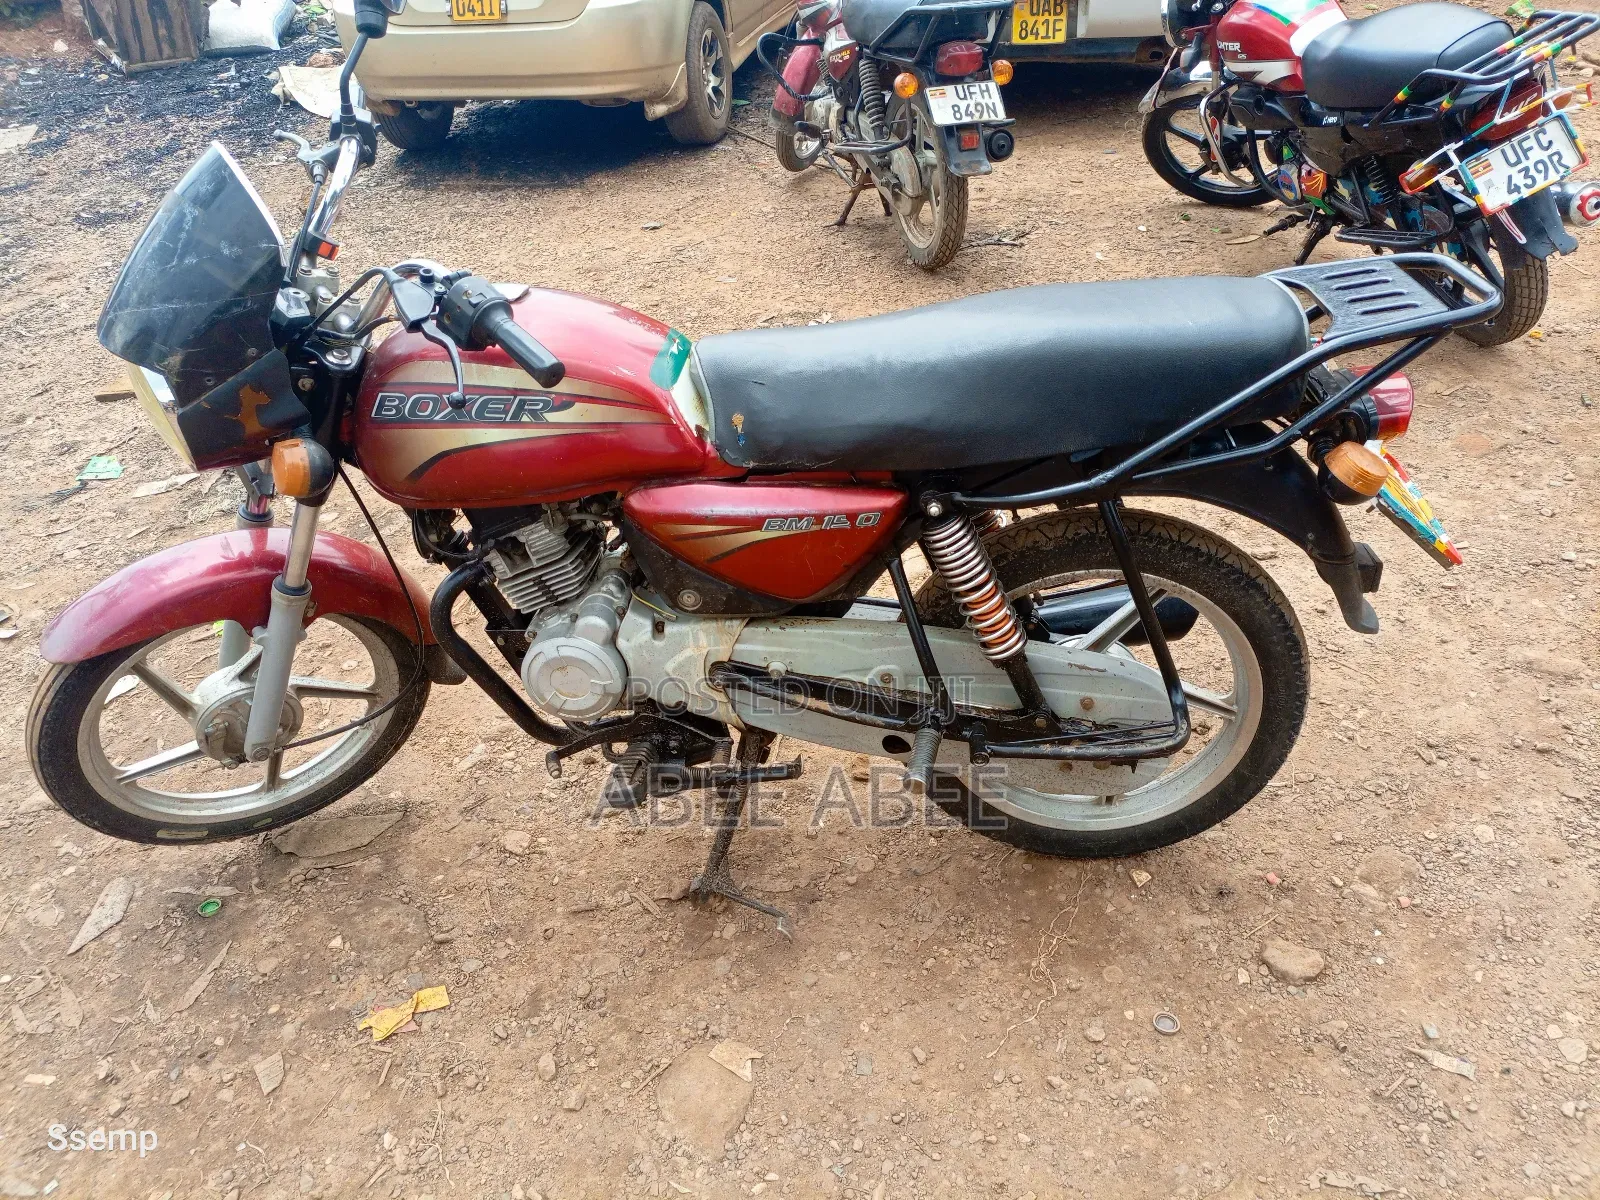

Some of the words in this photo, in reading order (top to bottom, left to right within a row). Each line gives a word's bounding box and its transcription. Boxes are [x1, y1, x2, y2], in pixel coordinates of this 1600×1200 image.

[1029, 0, 1064, 17] UAB
[1018, 19, 1064, 41] 841F
[954, 83, 993, 101] UFH
[951, 101, 999, 121] 849N
[1501, 127, 1554, 168] UFC
[1506, 150, 1571, 195] 439R
[370, 391, 556, 423] BOXER
[761, 516, 815, 532] BM
